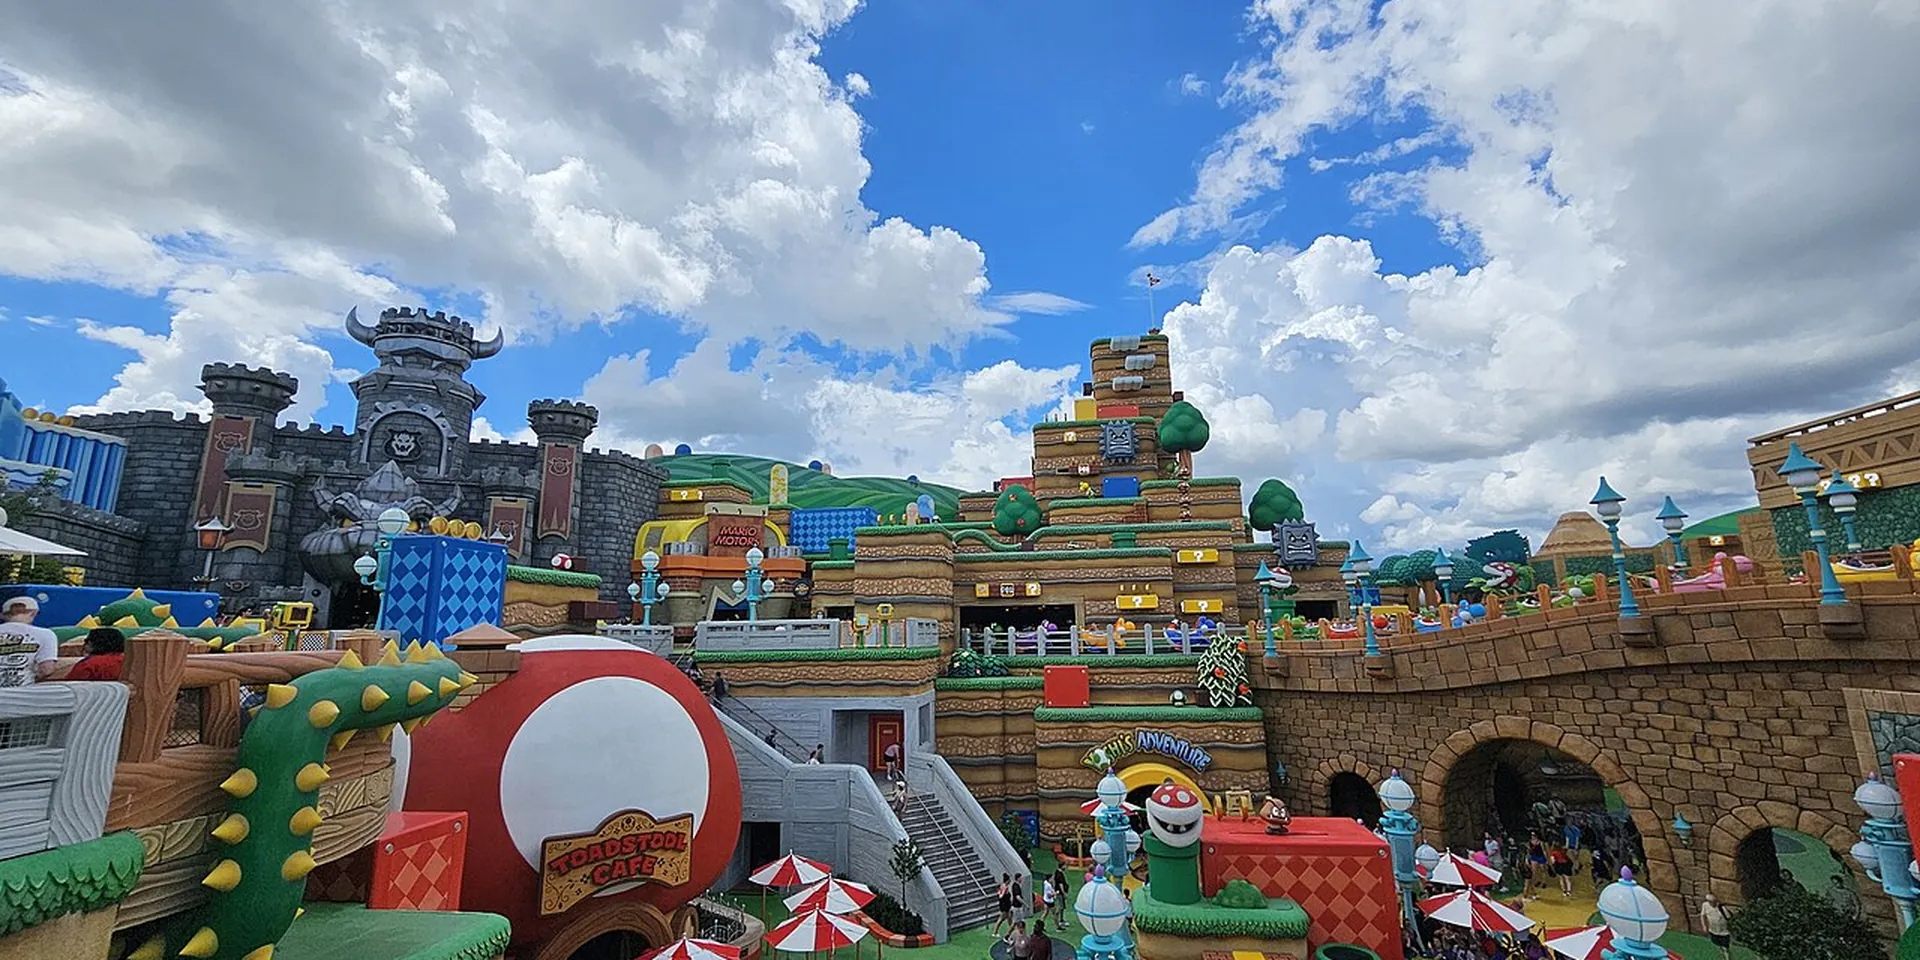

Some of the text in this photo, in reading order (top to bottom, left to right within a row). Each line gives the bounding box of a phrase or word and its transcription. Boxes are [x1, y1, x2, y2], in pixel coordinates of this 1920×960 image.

[715, 536, 760, 546] MOTORS
[720, 526, 757, 536] MARIO
[1137, 729, 1212, 770] ADVENTURE
[549, 831, 688, 877] TOADSTOOL
[591, 855, 658, 886] CAFE
